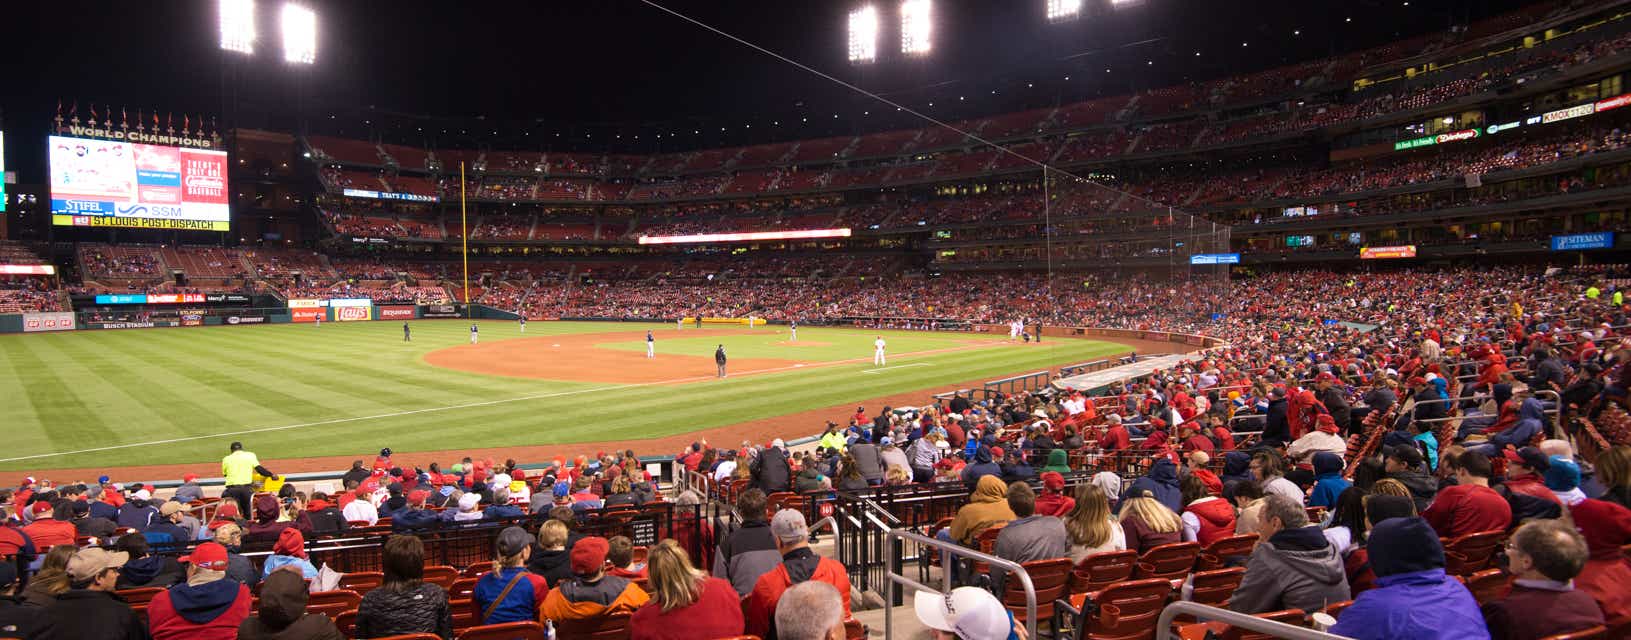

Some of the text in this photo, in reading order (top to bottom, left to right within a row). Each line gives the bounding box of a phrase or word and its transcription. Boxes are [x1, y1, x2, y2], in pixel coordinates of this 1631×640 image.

[69, 125, 211, 148] WORLD CHAMPIONS
[65, 200, 103, 211] STIFEL
[151, 206, 182, 217] SSM
[93, 215, 107, 226] ST.
[109, 216, 139, 227] LOUIS
[142, 218, 214, 230] POST-DISPATCH
[1568, 235, 1605, 243] SITEMAN
[126, 321, 154, 329] STADIUM
[822, 505, 832, 514] 161
